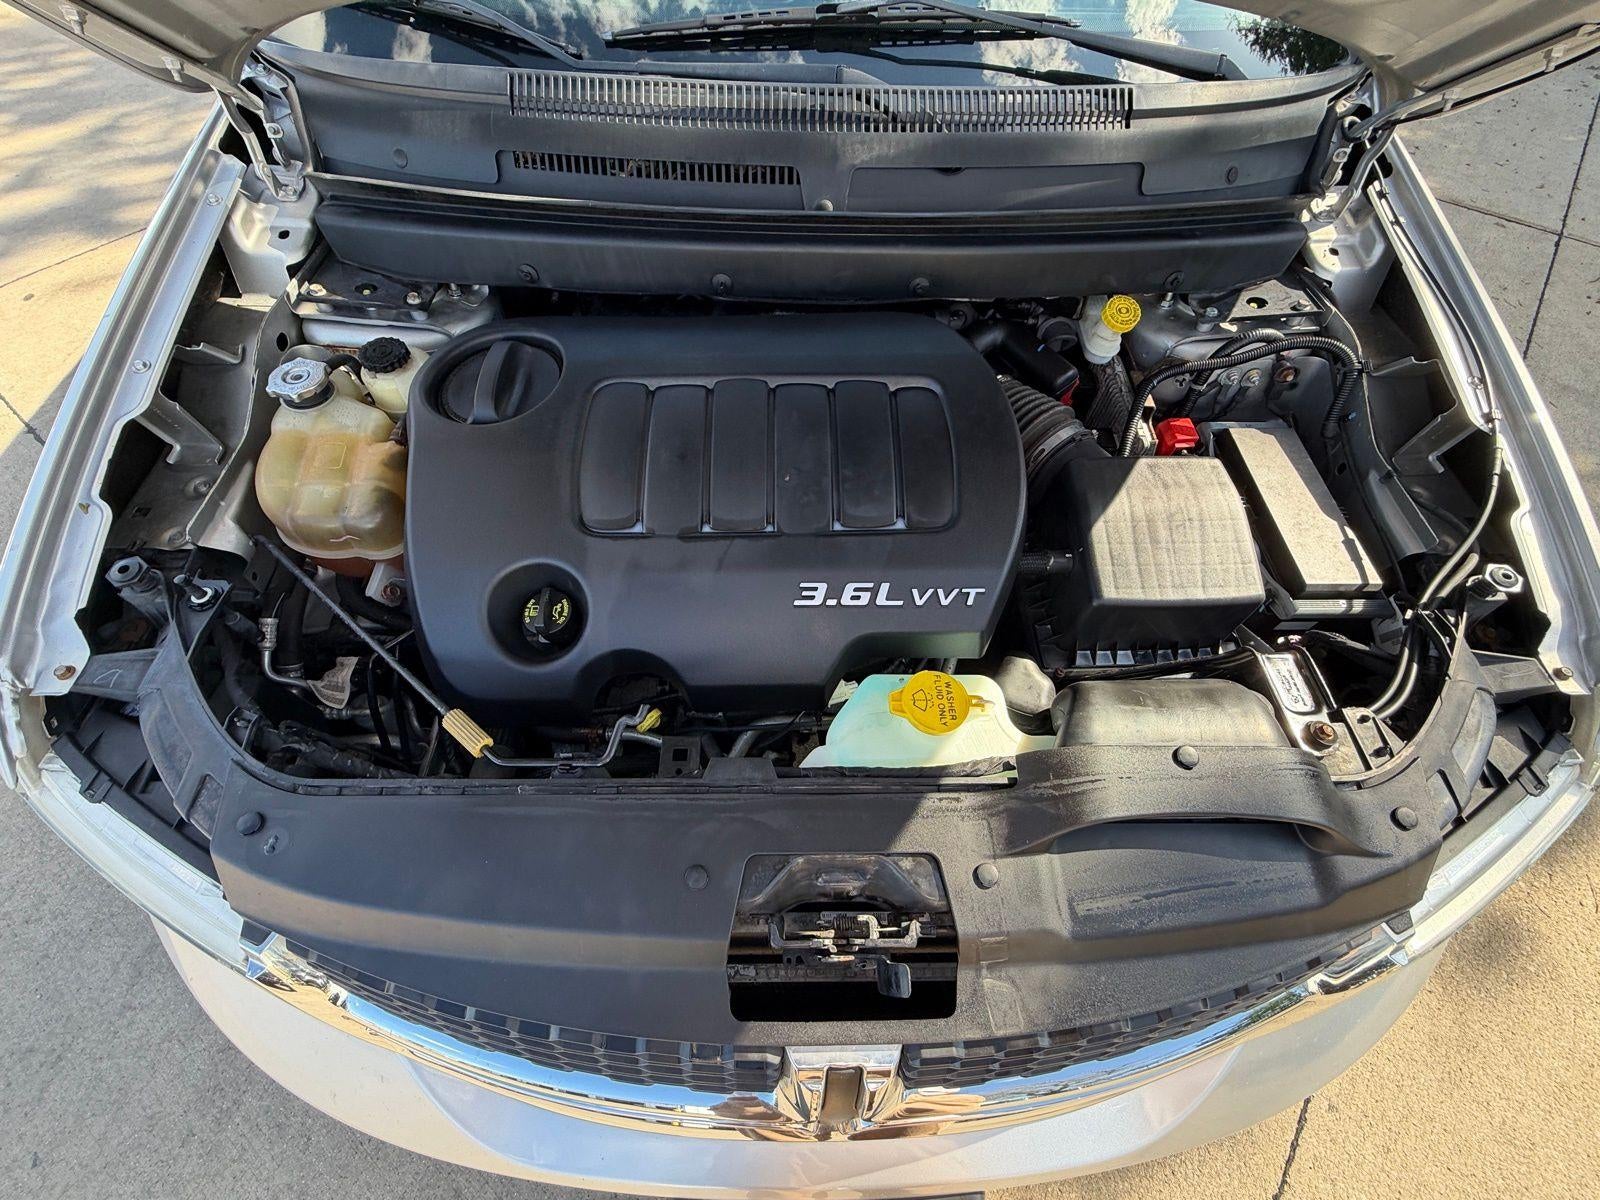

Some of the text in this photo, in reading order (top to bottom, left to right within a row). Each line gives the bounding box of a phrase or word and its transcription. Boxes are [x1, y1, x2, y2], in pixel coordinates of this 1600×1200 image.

[793, 582, 986, 606] 3.6L VVT
[933, 674, 949, 727] FLUID ONLY
[943, 681, 958, 722] WASHER
